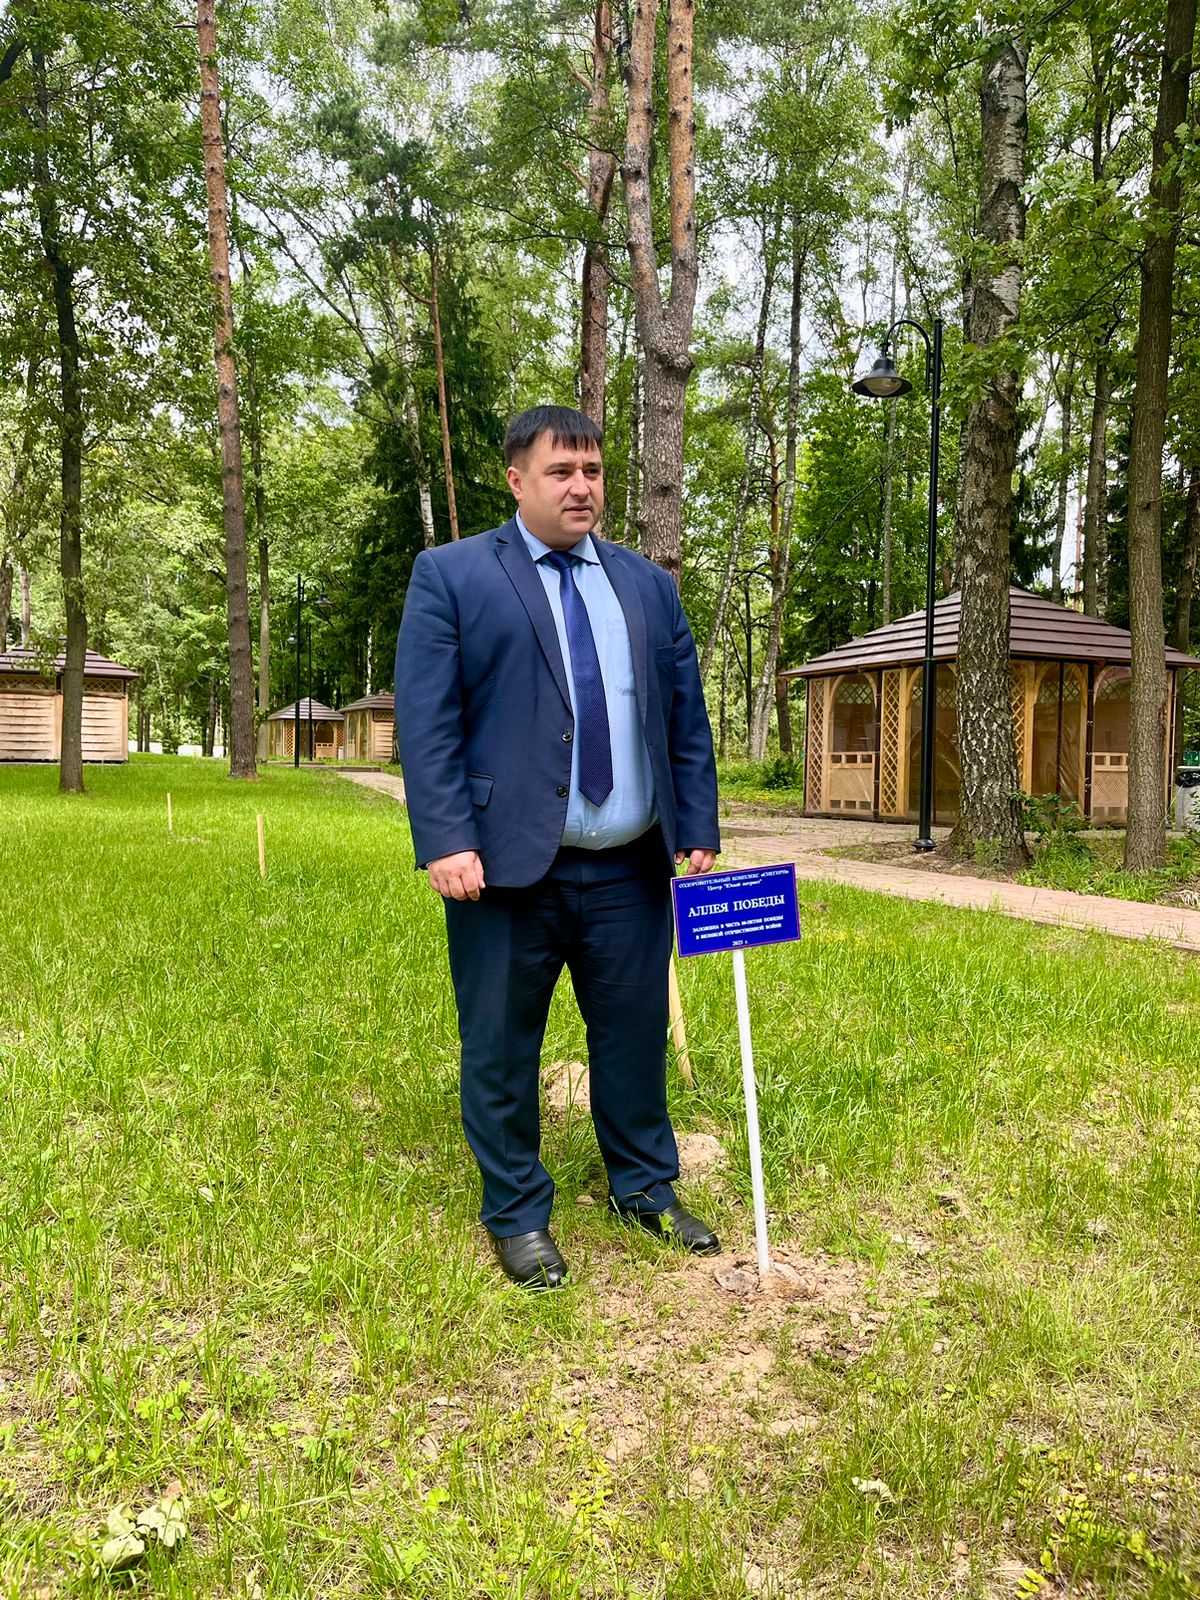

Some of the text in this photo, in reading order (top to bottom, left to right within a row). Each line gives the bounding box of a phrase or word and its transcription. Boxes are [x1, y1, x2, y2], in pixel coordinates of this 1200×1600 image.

[688, 894, 785, 918] АЛЛЕЯ ПОБЕДЫ
[763, 915, 784, 923] ПОБЕДЫ
[700, 931, 724, 939] ВЕЛИКОЙ
[724, 925, 765, 936] ОТЕЧЕСТВЕННОЙ
